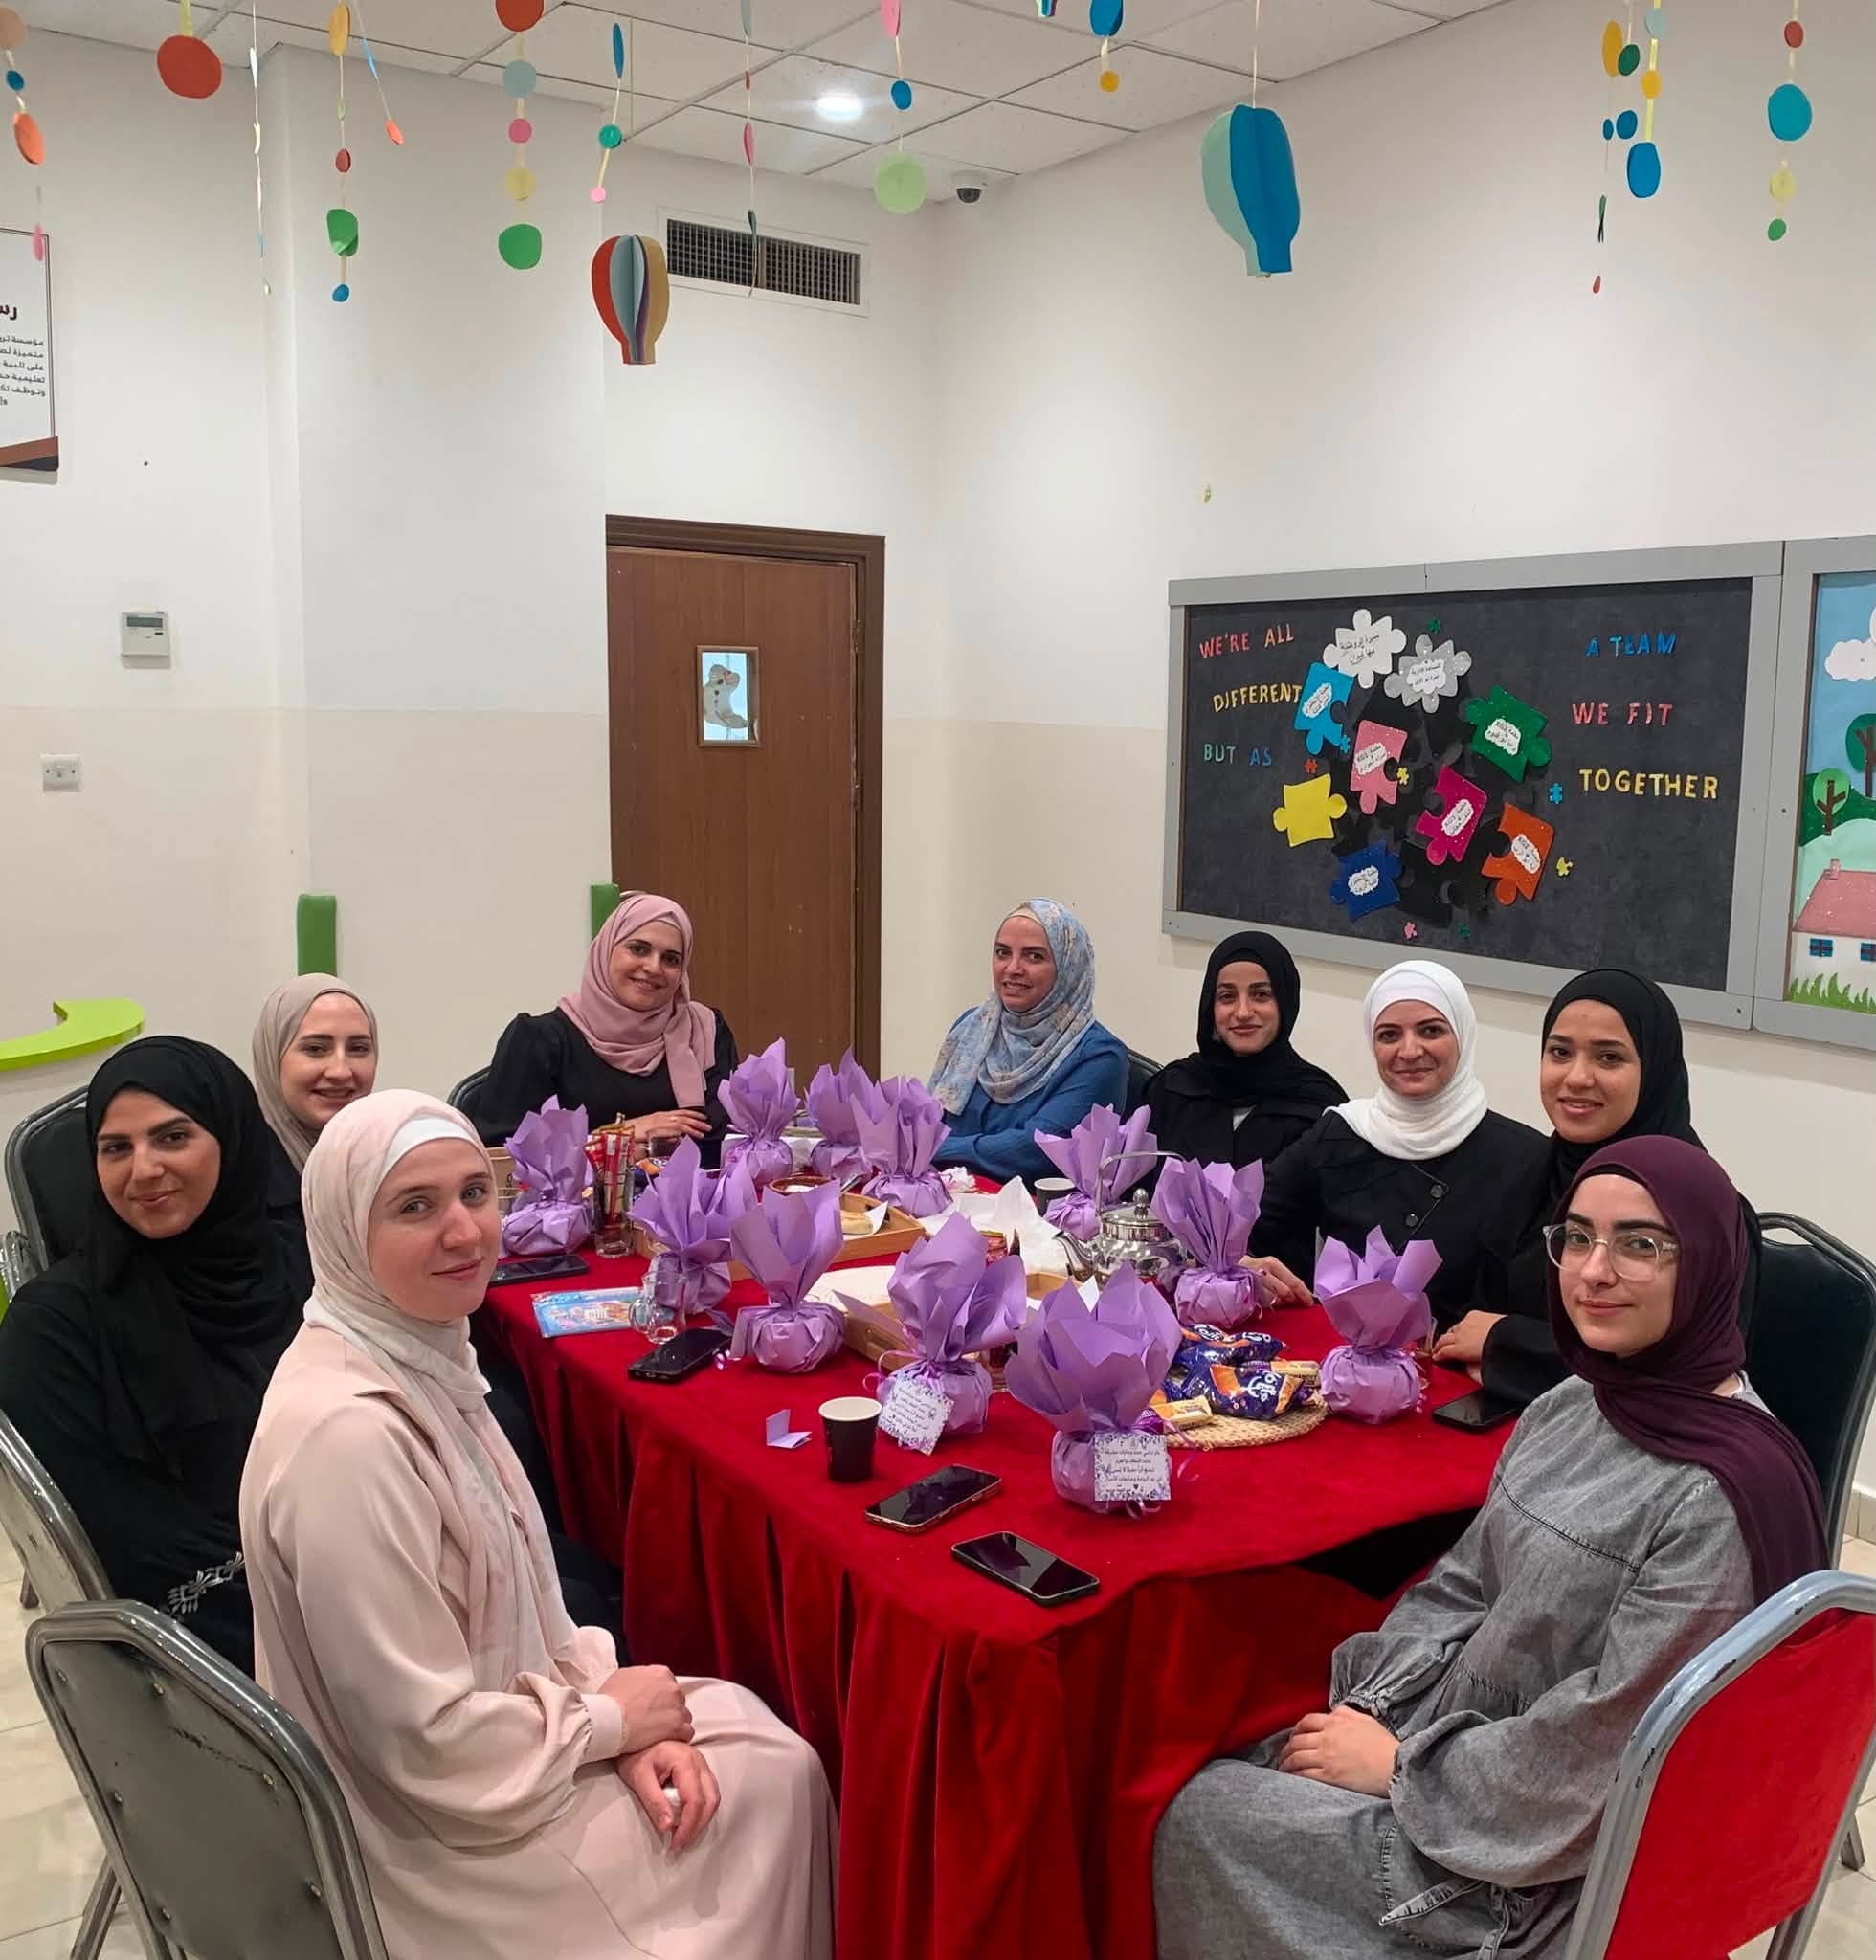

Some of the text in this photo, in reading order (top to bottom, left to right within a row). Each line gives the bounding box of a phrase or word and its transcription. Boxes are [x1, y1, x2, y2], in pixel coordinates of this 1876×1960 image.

[11, 336, 44, 346] مؤسسة
[12, 347, 44, 358] متميزة
[11, 372, 46, 384] تعليمية
[26, 363, 44, 371] على
[11, 385, 46, 397] وتوظف
[1199, 623, 1294, 659] WE'RE ALL
[1585, 632, 1677, 657] A TEAM
[1213, 682, 1303, 712] DIFFERENT
[1572, 702, 1673, 725] WE FIT
[1204, 744, 1272, 767] BUT AS
[1579, 768, 1719, 799] TOGETHER
